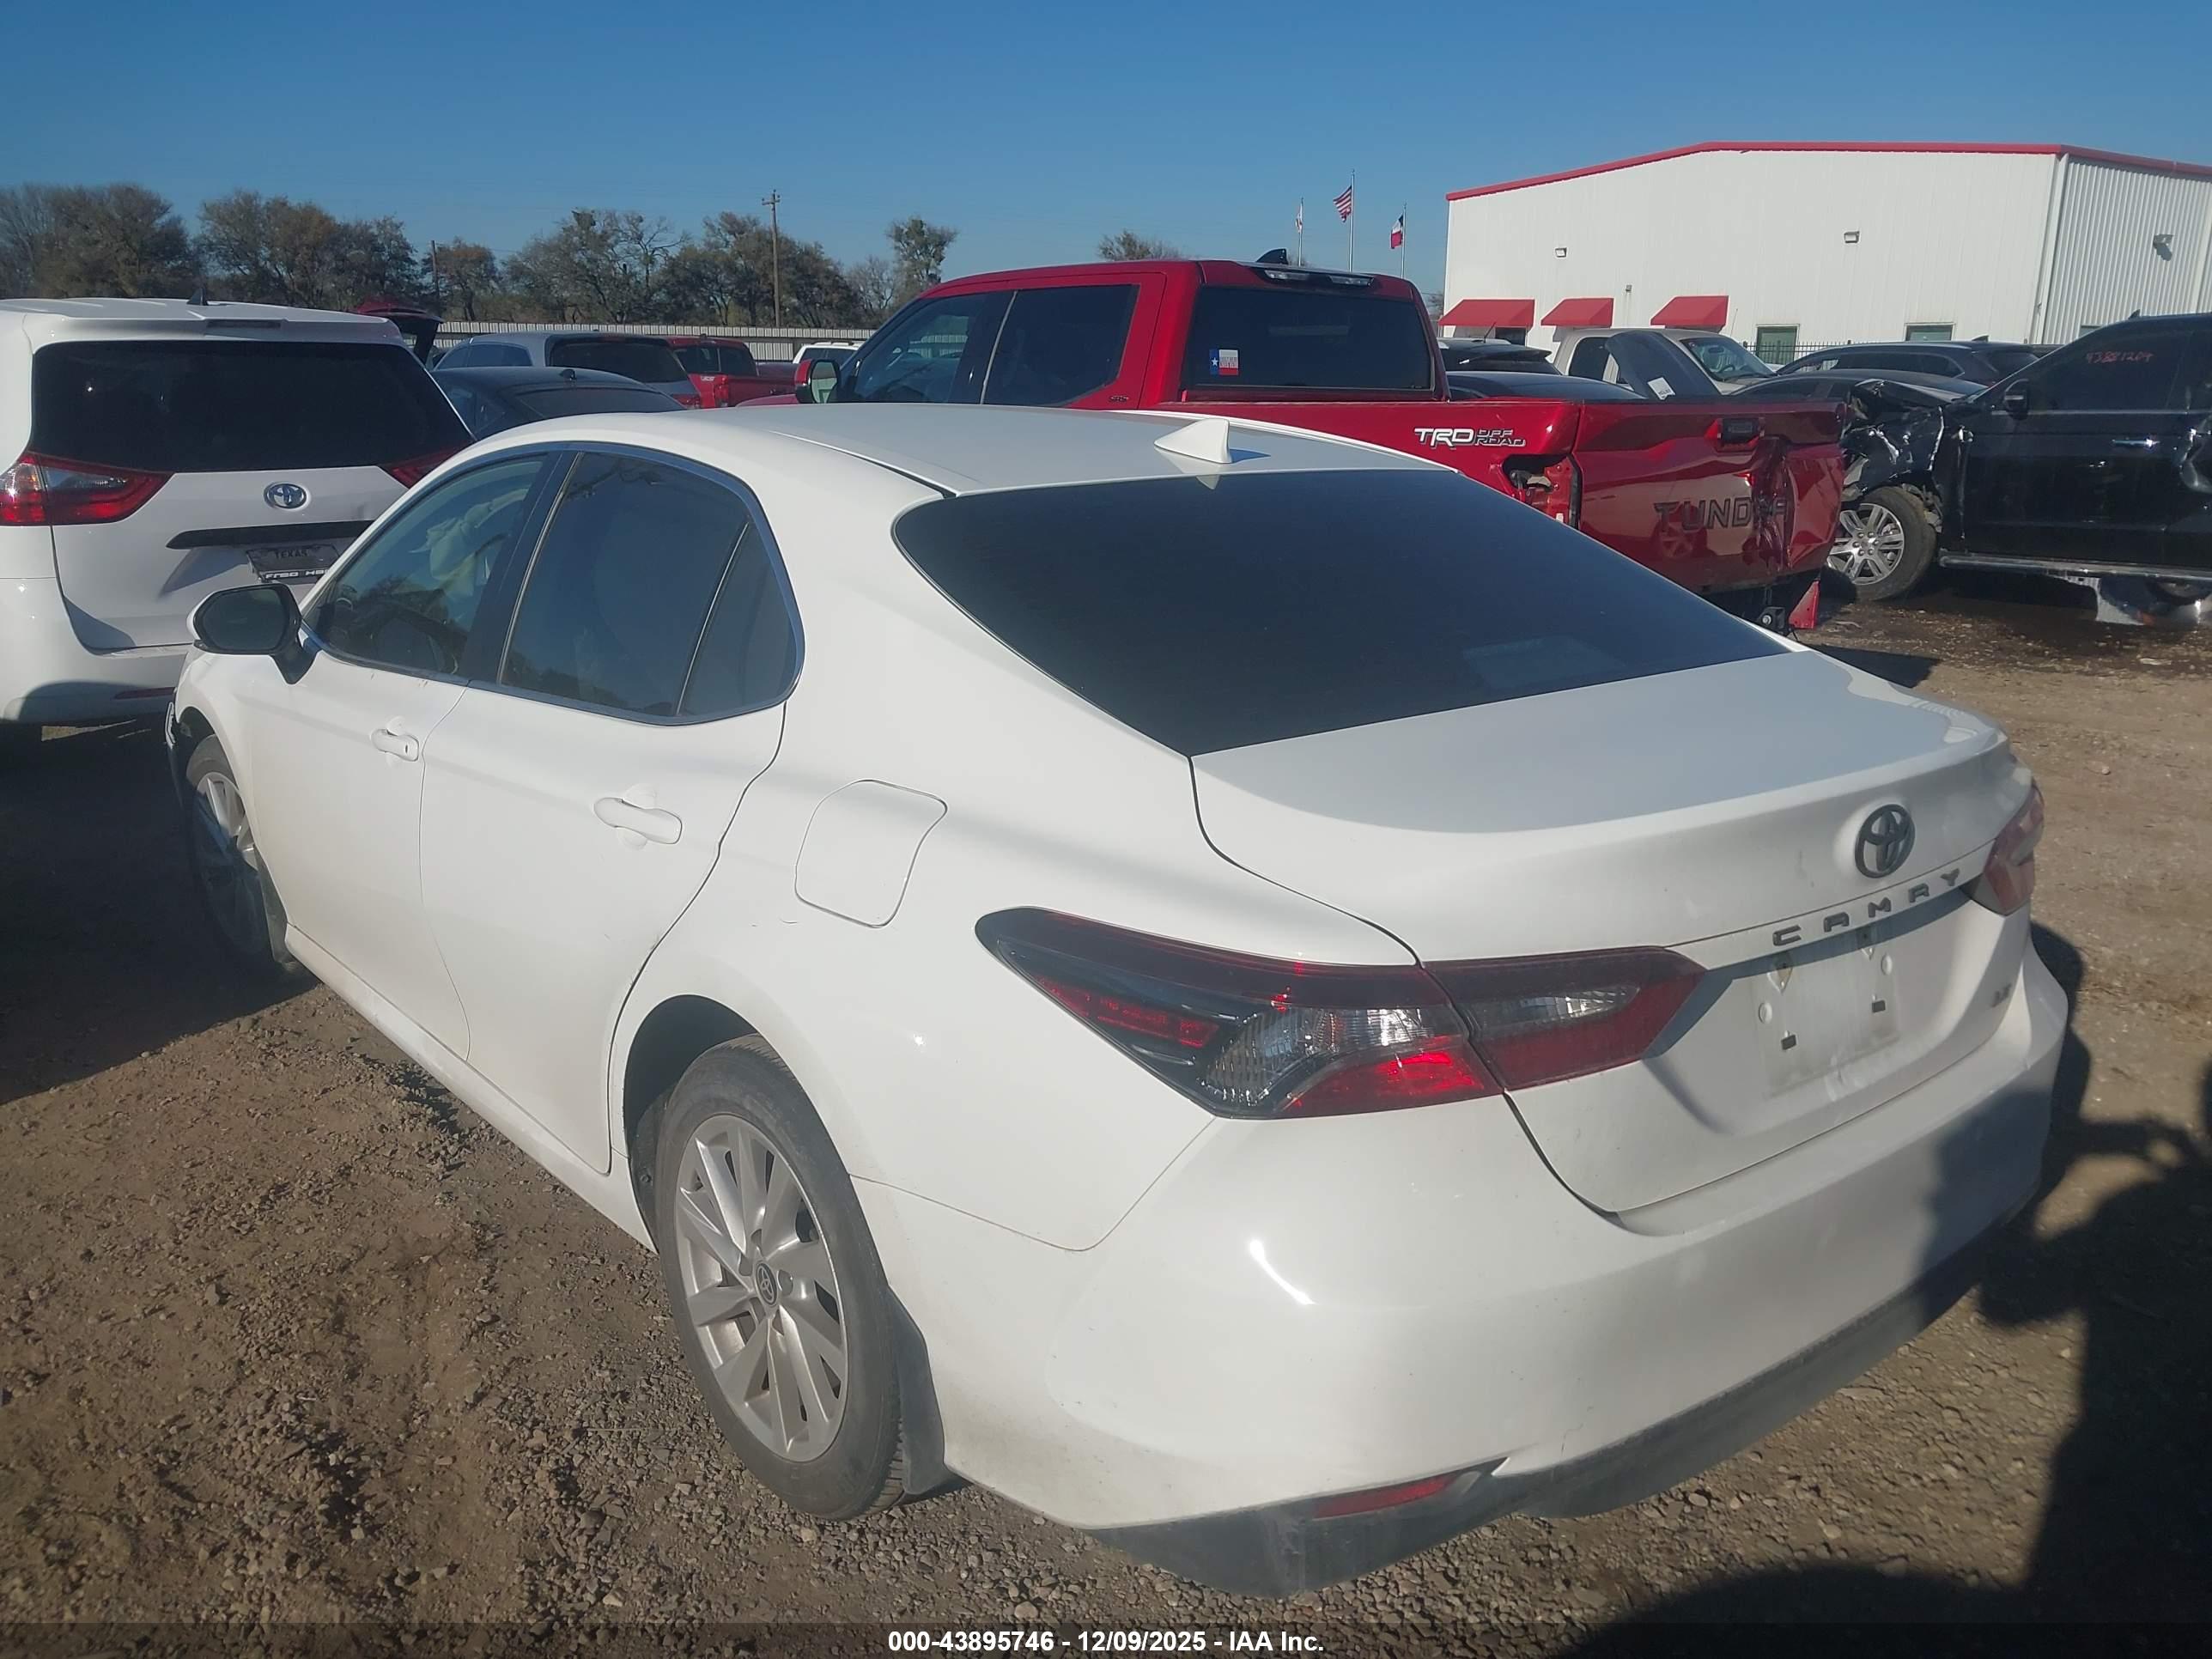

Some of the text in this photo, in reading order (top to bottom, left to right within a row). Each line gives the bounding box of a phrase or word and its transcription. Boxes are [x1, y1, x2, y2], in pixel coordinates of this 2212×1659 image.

[1477, 428, 1514, 438] OFF
[1413, 428, 1474, 449] TRD
[1475, 437, 1527, 447] ROAD
[275, 548, 307, 558] TEXAS
[1771, 867, 1960, 947] CAMRY
